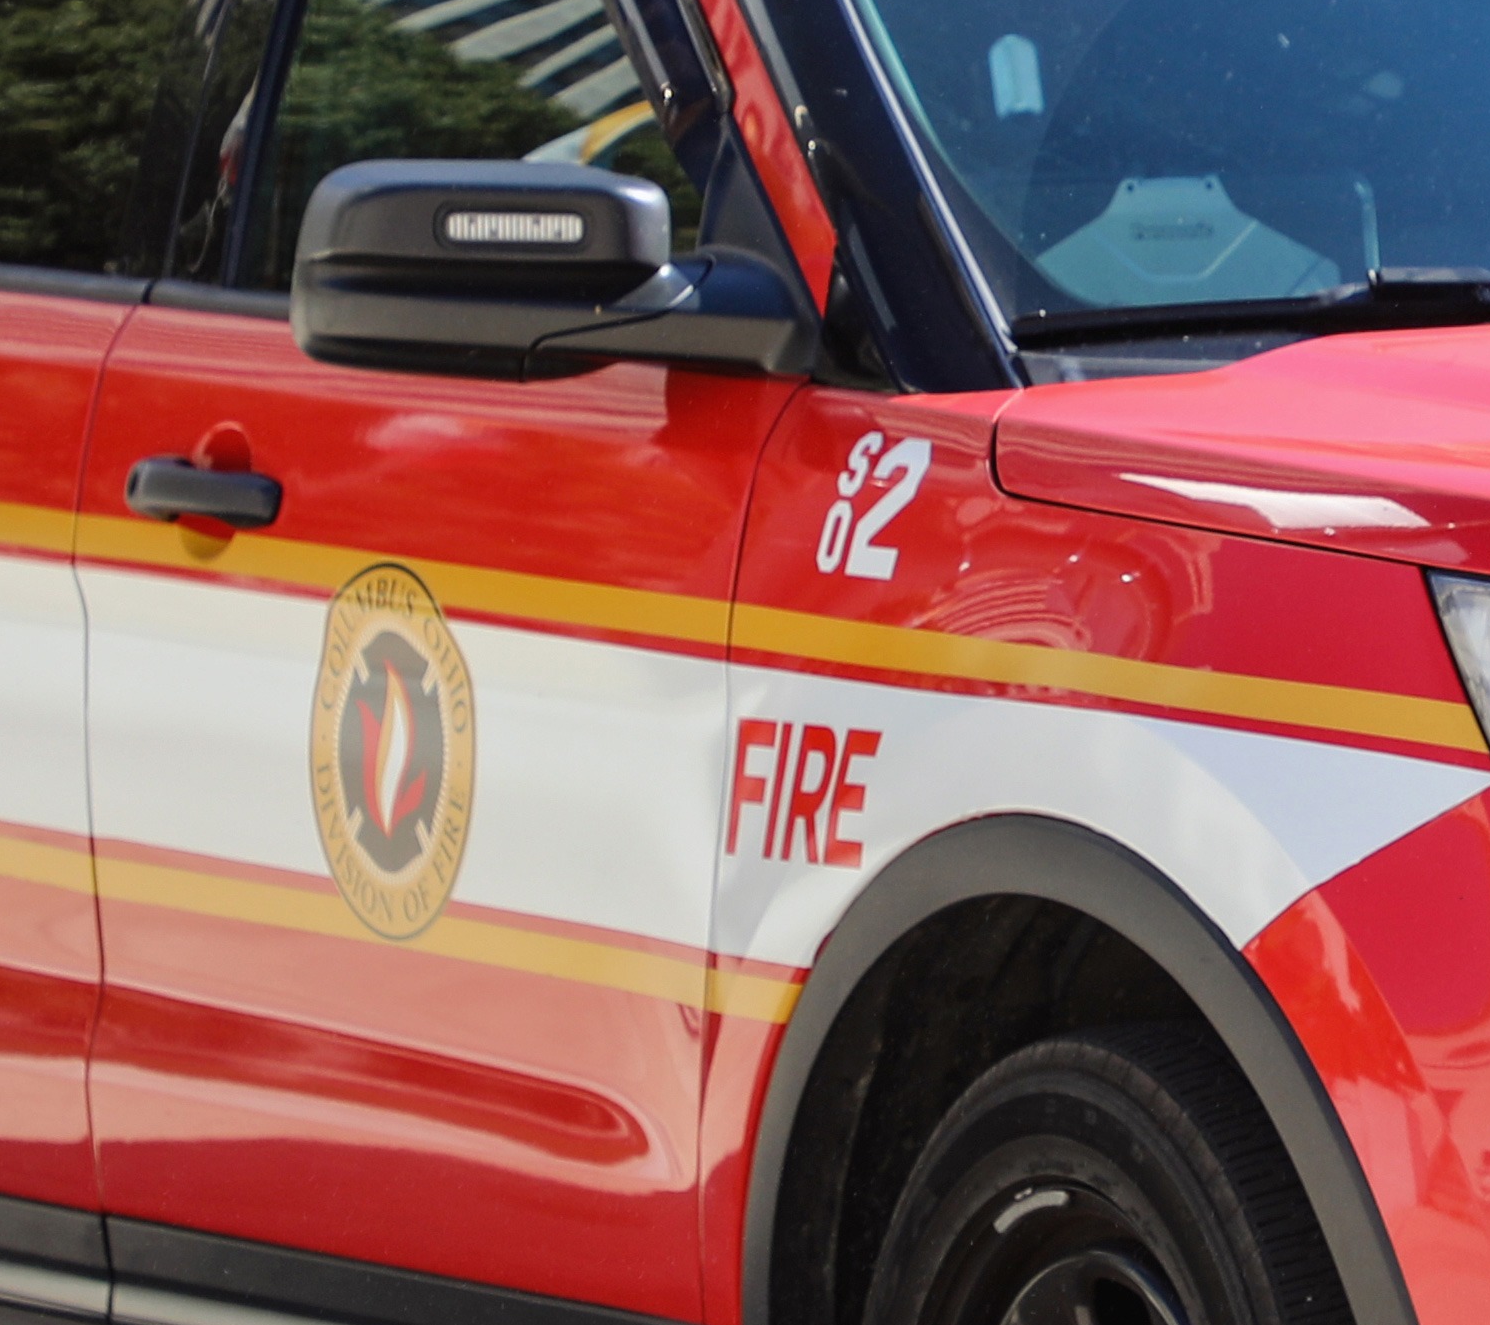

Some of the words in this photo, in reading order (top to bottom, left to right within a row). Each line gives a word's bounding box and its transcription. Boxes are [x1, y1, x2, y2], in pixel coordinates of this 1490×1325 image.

[844, 437, 932, 581] 2
[423, 617, 469, 734] OHIO
[316, 762, 394, 924] DIVISION
[402, 880, 430, 923] OF
[725, 718, 883, 869] FIRE
